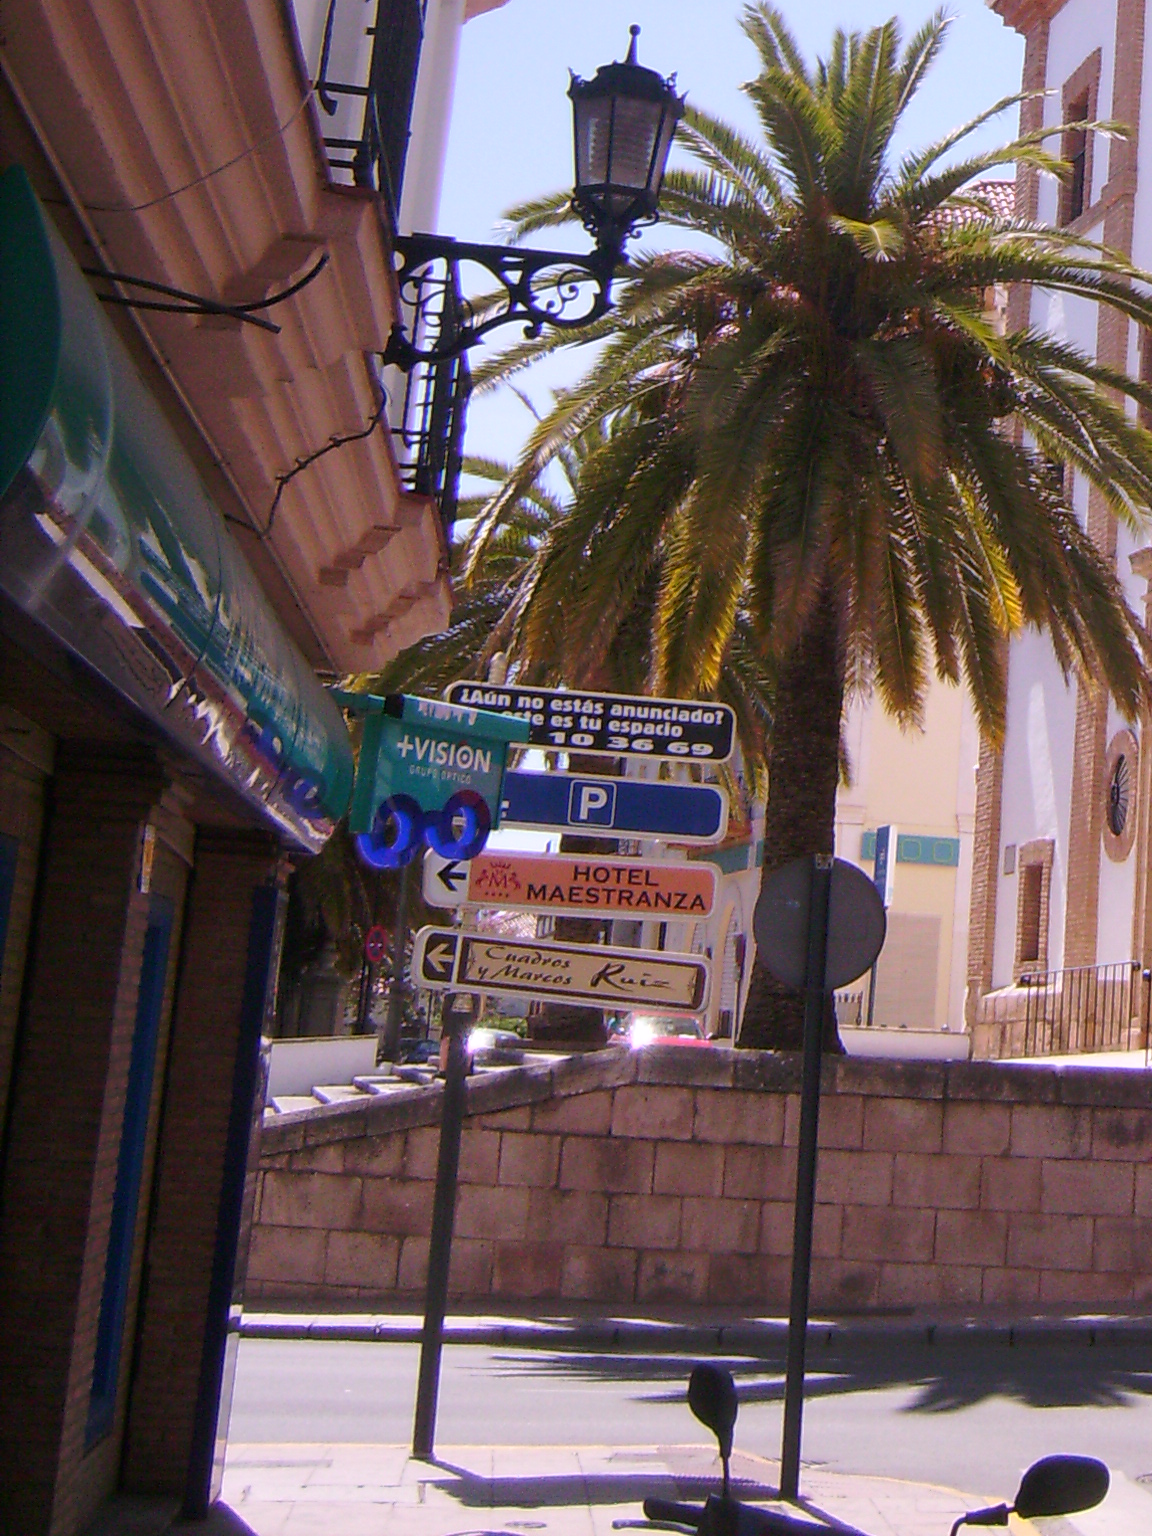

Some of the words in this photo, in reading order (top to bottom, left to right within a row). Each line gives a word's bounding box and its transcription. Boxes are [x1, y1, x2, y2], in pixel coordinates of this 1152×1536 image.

[459, 687, 512, 707] ¿Aún
[517, 695, 545, 710] no
[550, 697, 604, 715] estás
[610, 703, 724, 725] anunciado?
[551, 714, 573, 728] es
[580, 715, 602, 731] tu
[608, 719, 683, 738] espacio
[548, 731, 595, 746] 10
[606, 735, 654, 752] 36
[667, 740, 714, 756] 69
[580, 786, 607, 820] P
[573, 864, 659, 887] HOTEL
[526, 884, 706, 911] MAESTRANZA
[485, 946, 570, 968] Cuadros
[478, 966, 489, 980] y
[490, 964, 572, 986] Marcos
[590, 963, 675, 992] Ruiz
